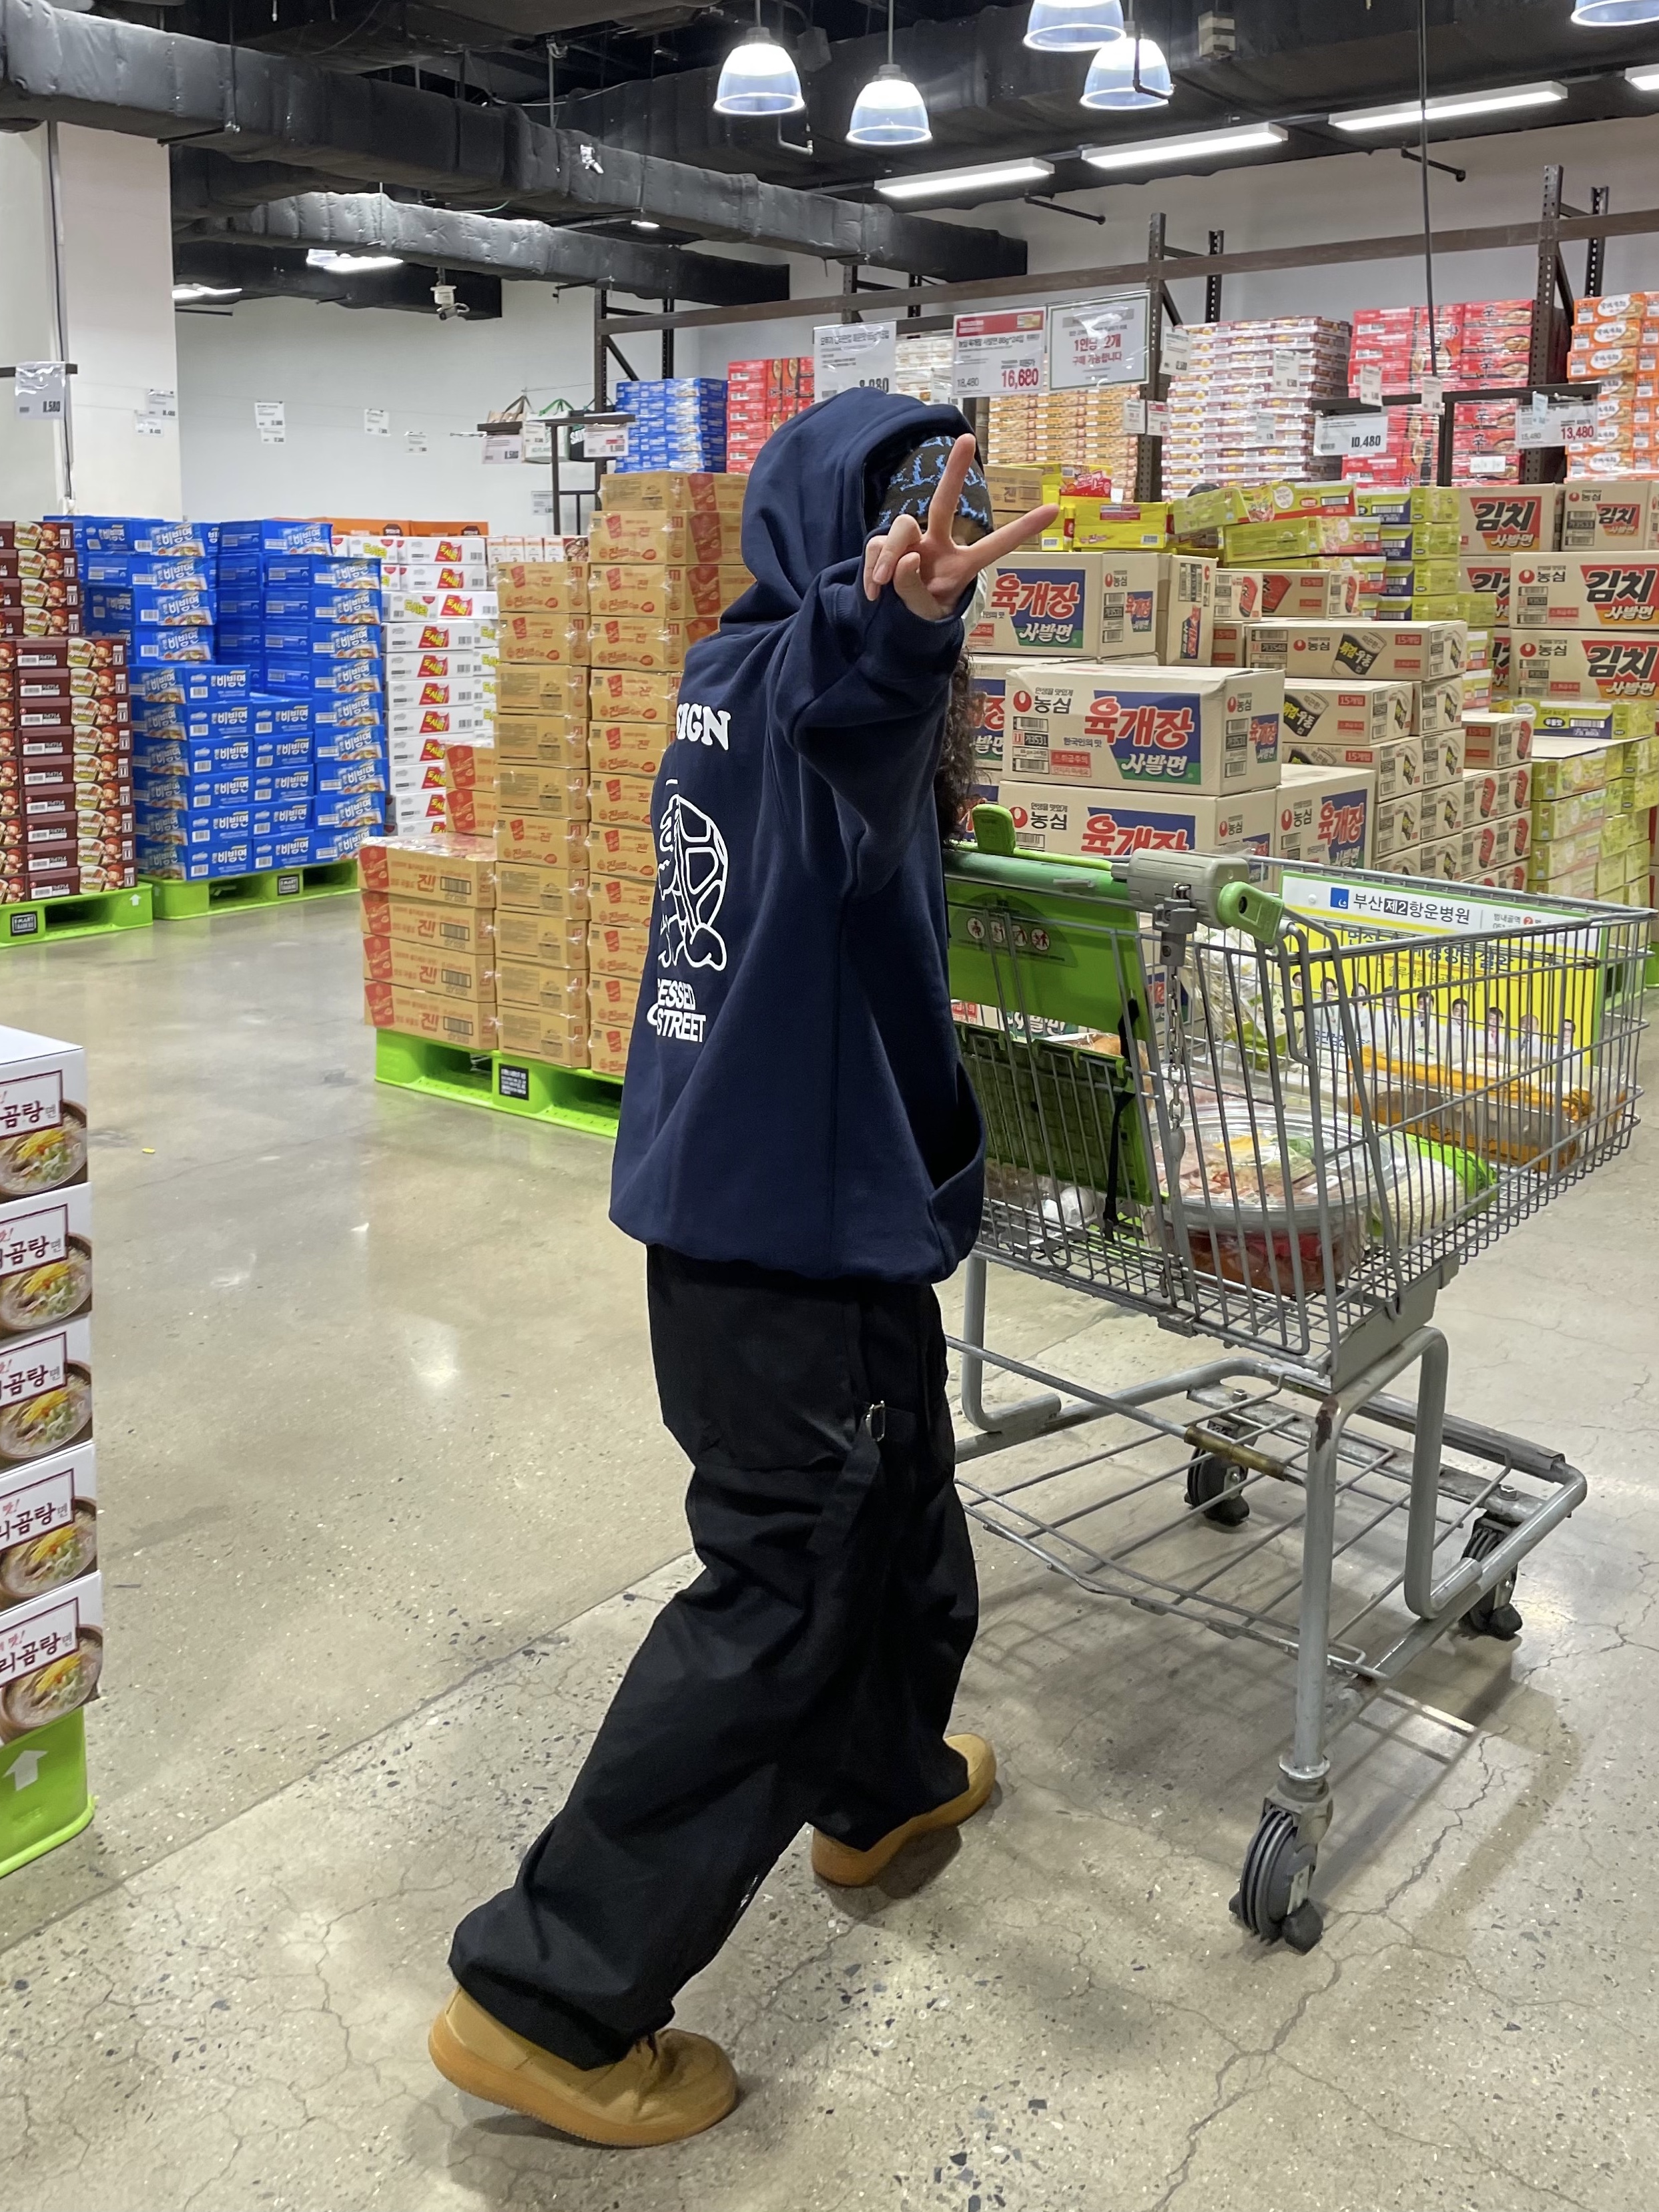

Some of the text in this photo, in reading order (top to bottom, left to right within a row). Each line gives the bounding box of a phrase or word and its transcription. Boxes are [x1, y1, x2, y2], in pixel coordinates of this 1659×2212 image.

[1104, 333, 1121, 348] 2개
[1351, 435, 1381, 448] 10,480
[1560, 425, 1594, 440] 13,480
[1475, 501, 1535, 531] 김치
[1598, 507, 1635, 524] 김치
[160, 526, 194, 545] 비빔면
[293, 527, 321, 545] 비빔면
[1491, 534, 1534, 547] 사발면
[163, 561, 195, 580] 비빔면
[1538, 571, 1566, 583] 농심
[1585, 570, 1656, 603] 김치
[168, 593, 200, 614] 비빔면
[342, 594, 370, 612] 비빔면
[991, 573, 1080, 619] 육개장
[1605, 605, 1654, 620] 사발면
[168, 629, 199, 649] 비빔면
[340, 630, 368, 647] 비빔면
[1018, 622, 1074, 643] 사발면
[1308, 641, 1330, 651] 농심
[1538, 645, 1567, 656] 농심
[1587, 645, 1658, 678] 김치
[216, 674, 246, 687] 비빔면
[342, 663, 370, 682] 비빔면
[1607, 681, 1656, 696] 사발면
[342, 699, 370, 716] 비빔면
[1034, 696, 1072, 714] 농심
[1237, 699, 1252, 712] 농심
[218, 711, 248, 724] 비빔면
[281, 709, 308, 722] 비빔면
[1084, 695, 1195, 750] 육개장
[282, 742, 309, 755] 비빔면
[344, 732, 372, 750] 비빔면
[975, 735, 1004, 755] 발면
[220, 746, 249, 760] 비빔면
[1120, 752, 1189, 777] 사발면
[280, 775, 309, 788] 비빔면
[347, 765, 375, 784] 비빔면
[220, 780, 249, 794] 비빔면
[279, 808, 307, 822] 비빔면
[344, 800, 372, 818] 비빔면
[1293, 808, 1312, 828] 농심
[219, 815, 249, 829] 비빔면
[1030, 812, 1068, 830] 농심
[1229, 820, 1243, 836] 농심
[1317, 801, 1364, 847] 육개장
[218, 848, 248, 863] 비빔면
[281, 840, 309, 855] 비빔면
[657, 978, 696, 1011] ESSED
[657, 1009, 707, 1043] STREET
[0, 1235, 61, 1266] 곰탕면
[0, 1365, 61, 1399] 곰탕면
